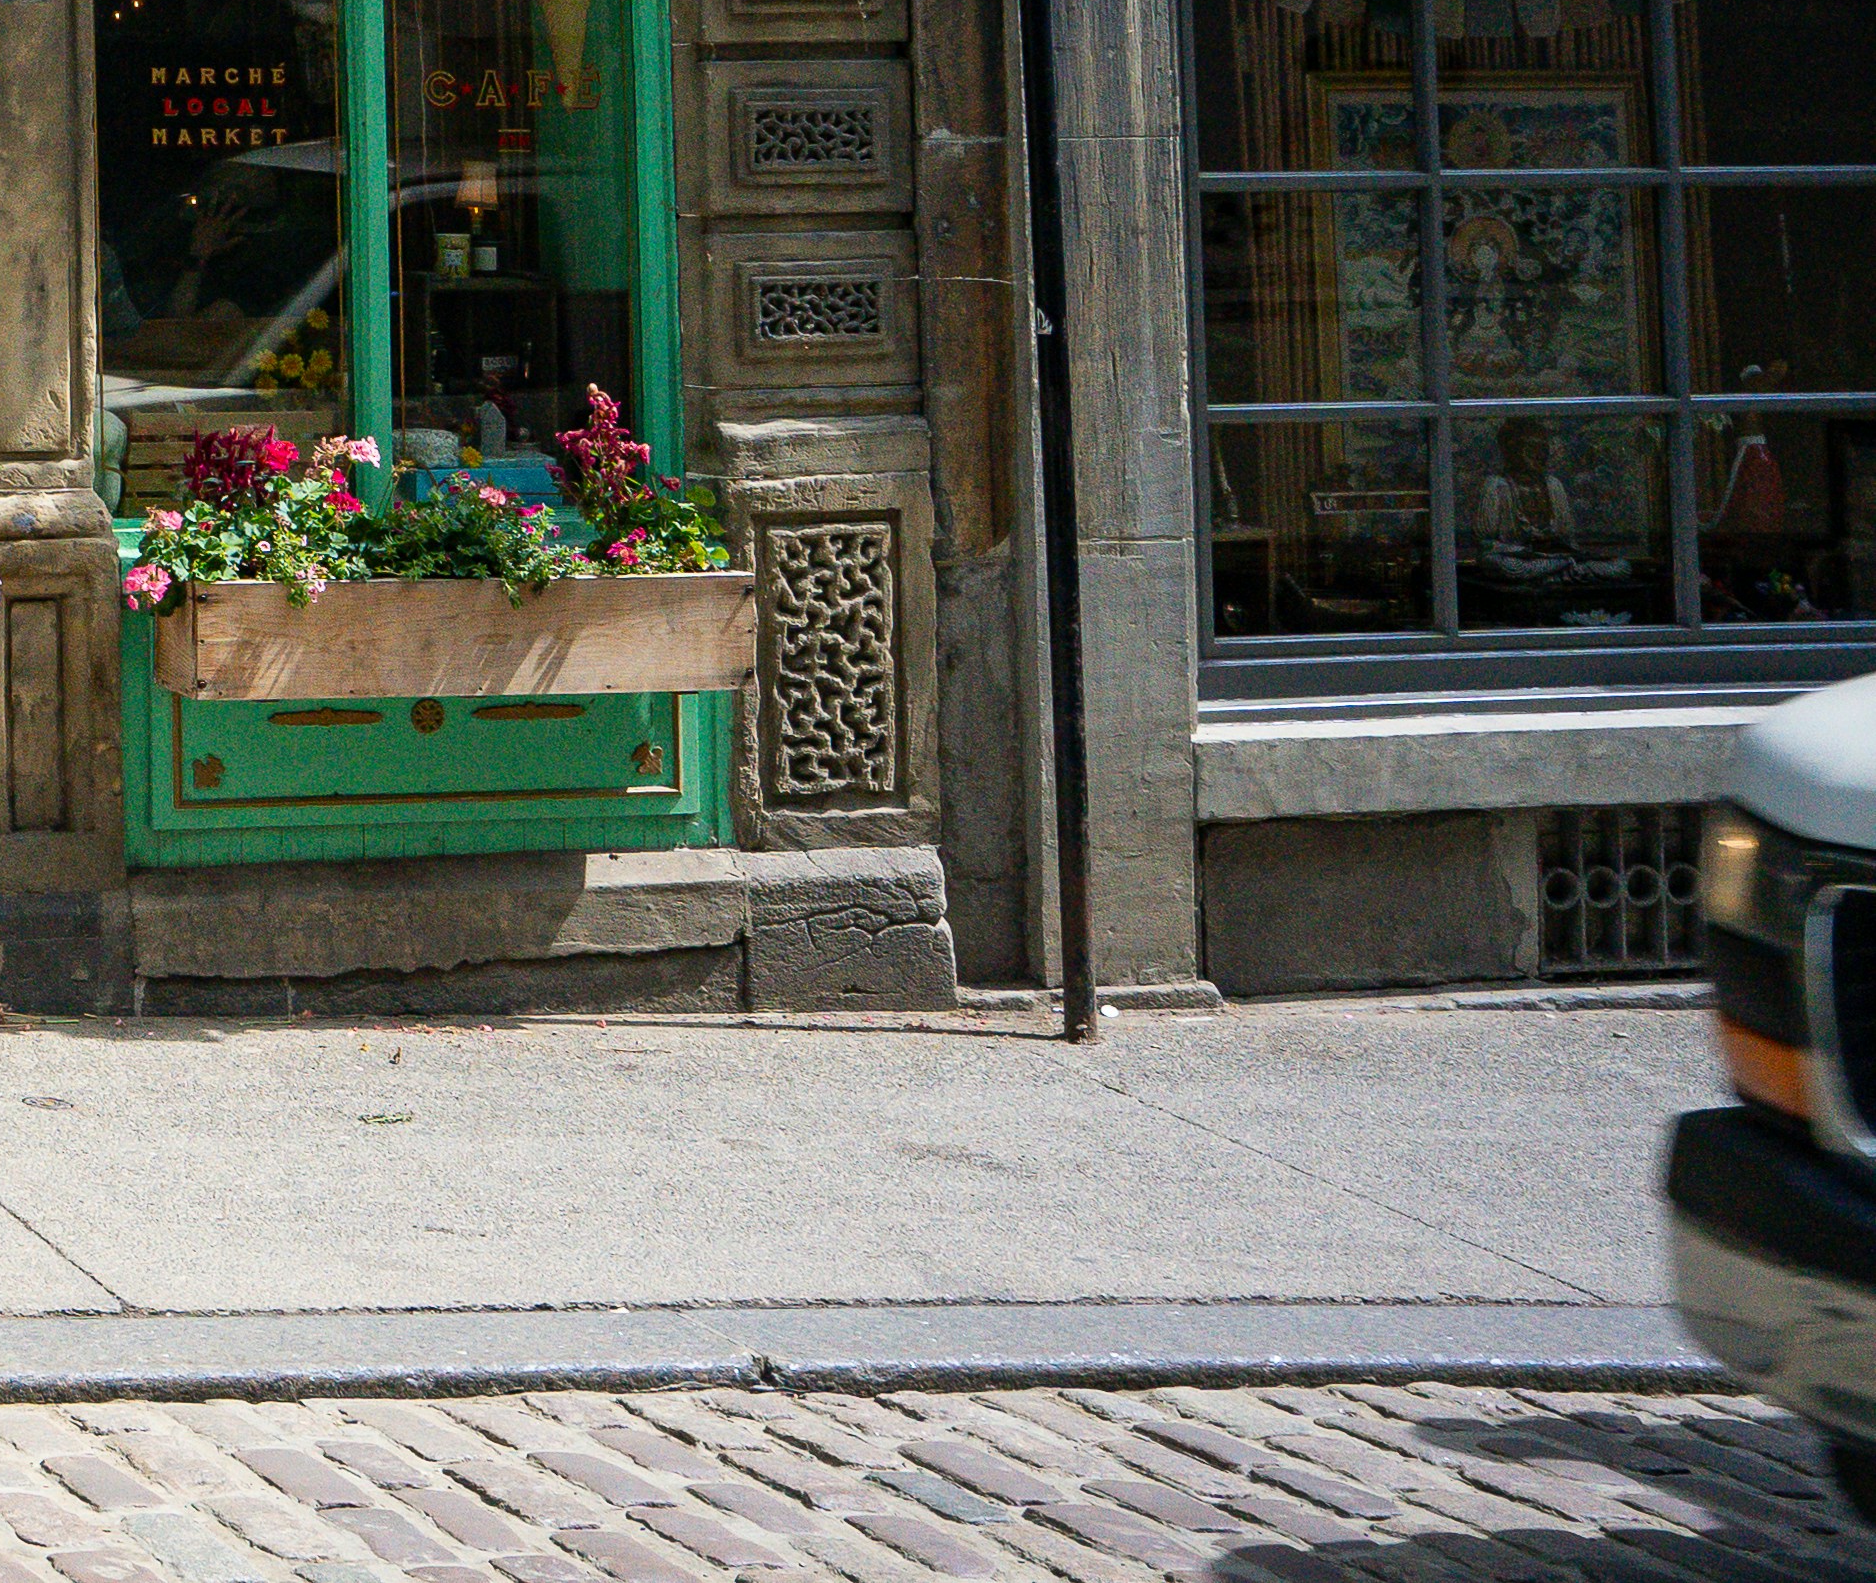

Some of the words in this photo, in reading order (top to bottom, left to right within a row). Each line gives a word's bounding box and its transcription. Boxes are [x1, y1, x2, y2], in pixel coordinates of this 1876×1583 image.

[150, 61, 286, 86] MARCHÉ
[162, 97, 277, 117] LOCAL
[151, 128, 288, 146] MARKET
[497, 133, 531, 147] ATM
